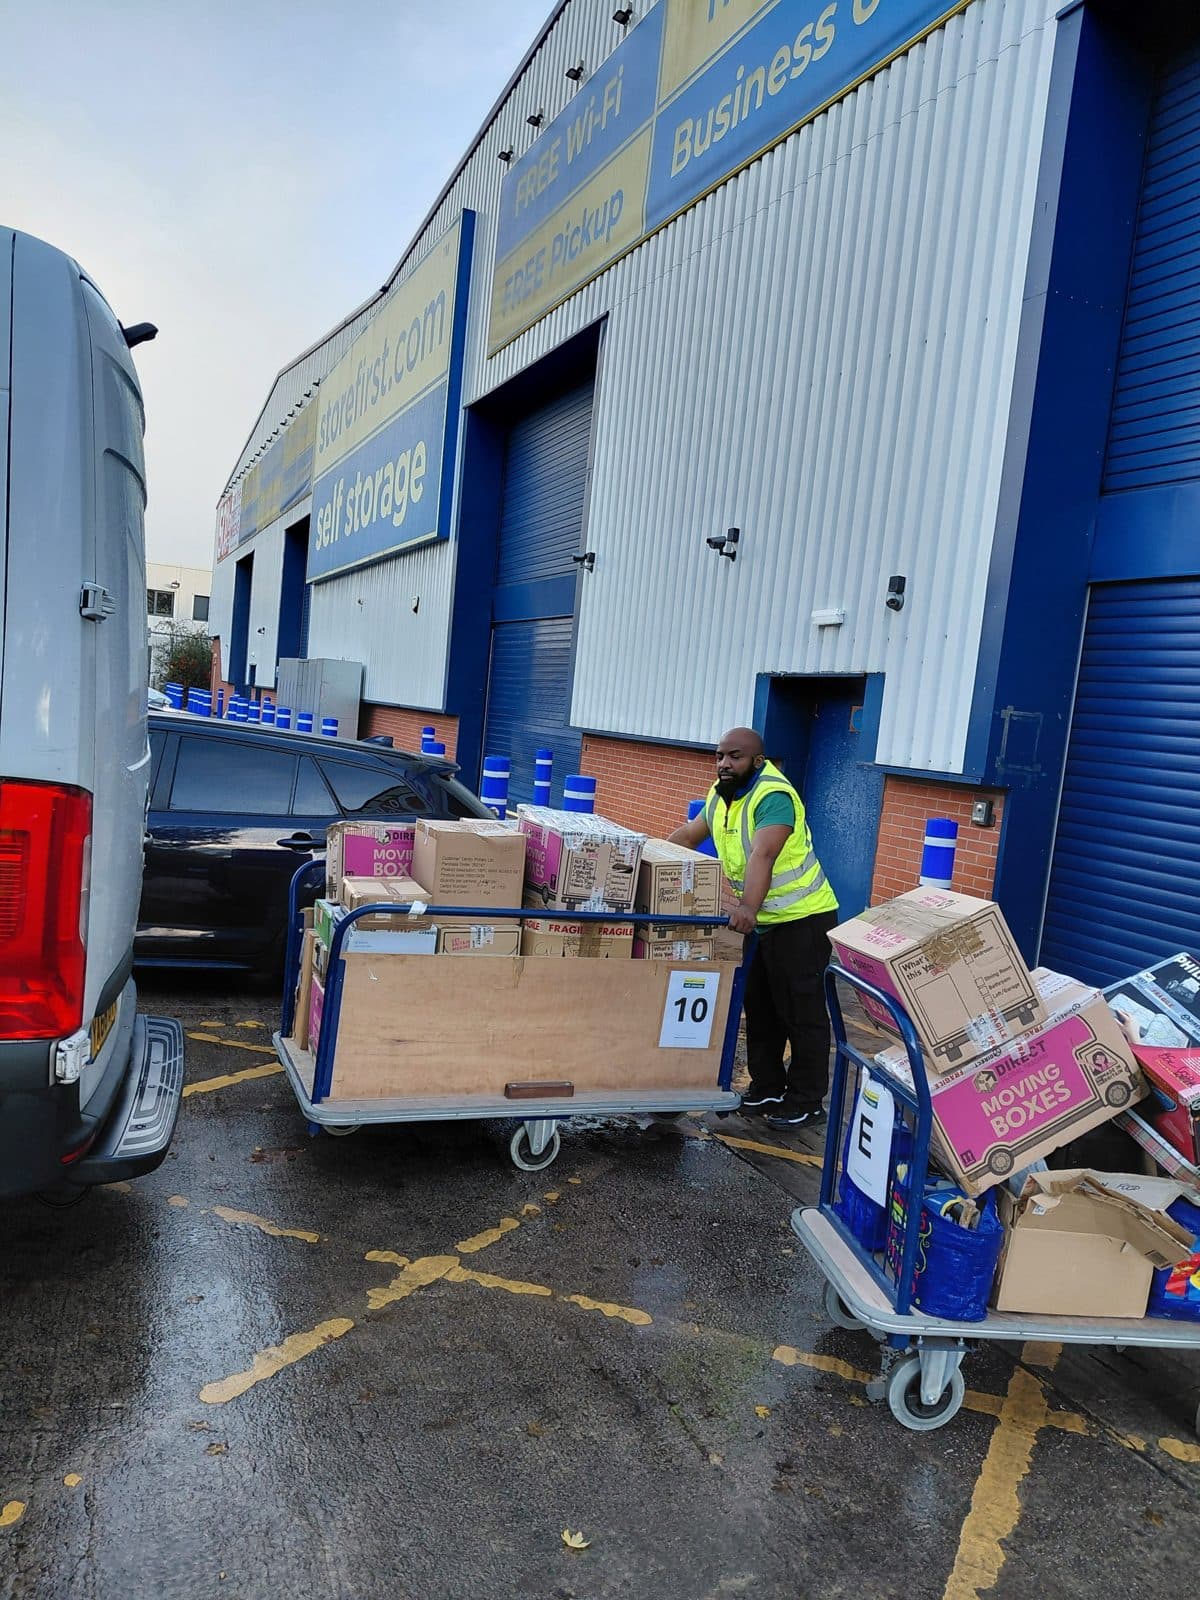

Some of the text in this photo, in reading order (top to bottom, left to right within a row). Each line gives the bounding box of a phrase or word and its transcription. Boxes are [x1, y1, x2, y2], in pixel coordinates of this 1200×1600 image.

[671, 2, 838, 178] Business
[515, 63, 624, 217] FREE Wi-Fi
[502, 189, 624, 315] FREE Pickup
[319, 289, 446, 454] storefirst.com
[315, 479, 344, 551] self
[344, 440, 426, 537] storage
[599, 927, 634, 937] FRAGILE
[907, 970, 922, 981] this
[674, 997, 708, 1023] 10
[987, 1007, 1009, 1039] FRAGILE
[934, 1070, 965, 1090] FRAGILE
[980, 1063, 1061, 1117] MOVING
[859, 1113, 874, 1159] E
[990, 1080, 1072, 1138] BOXES
